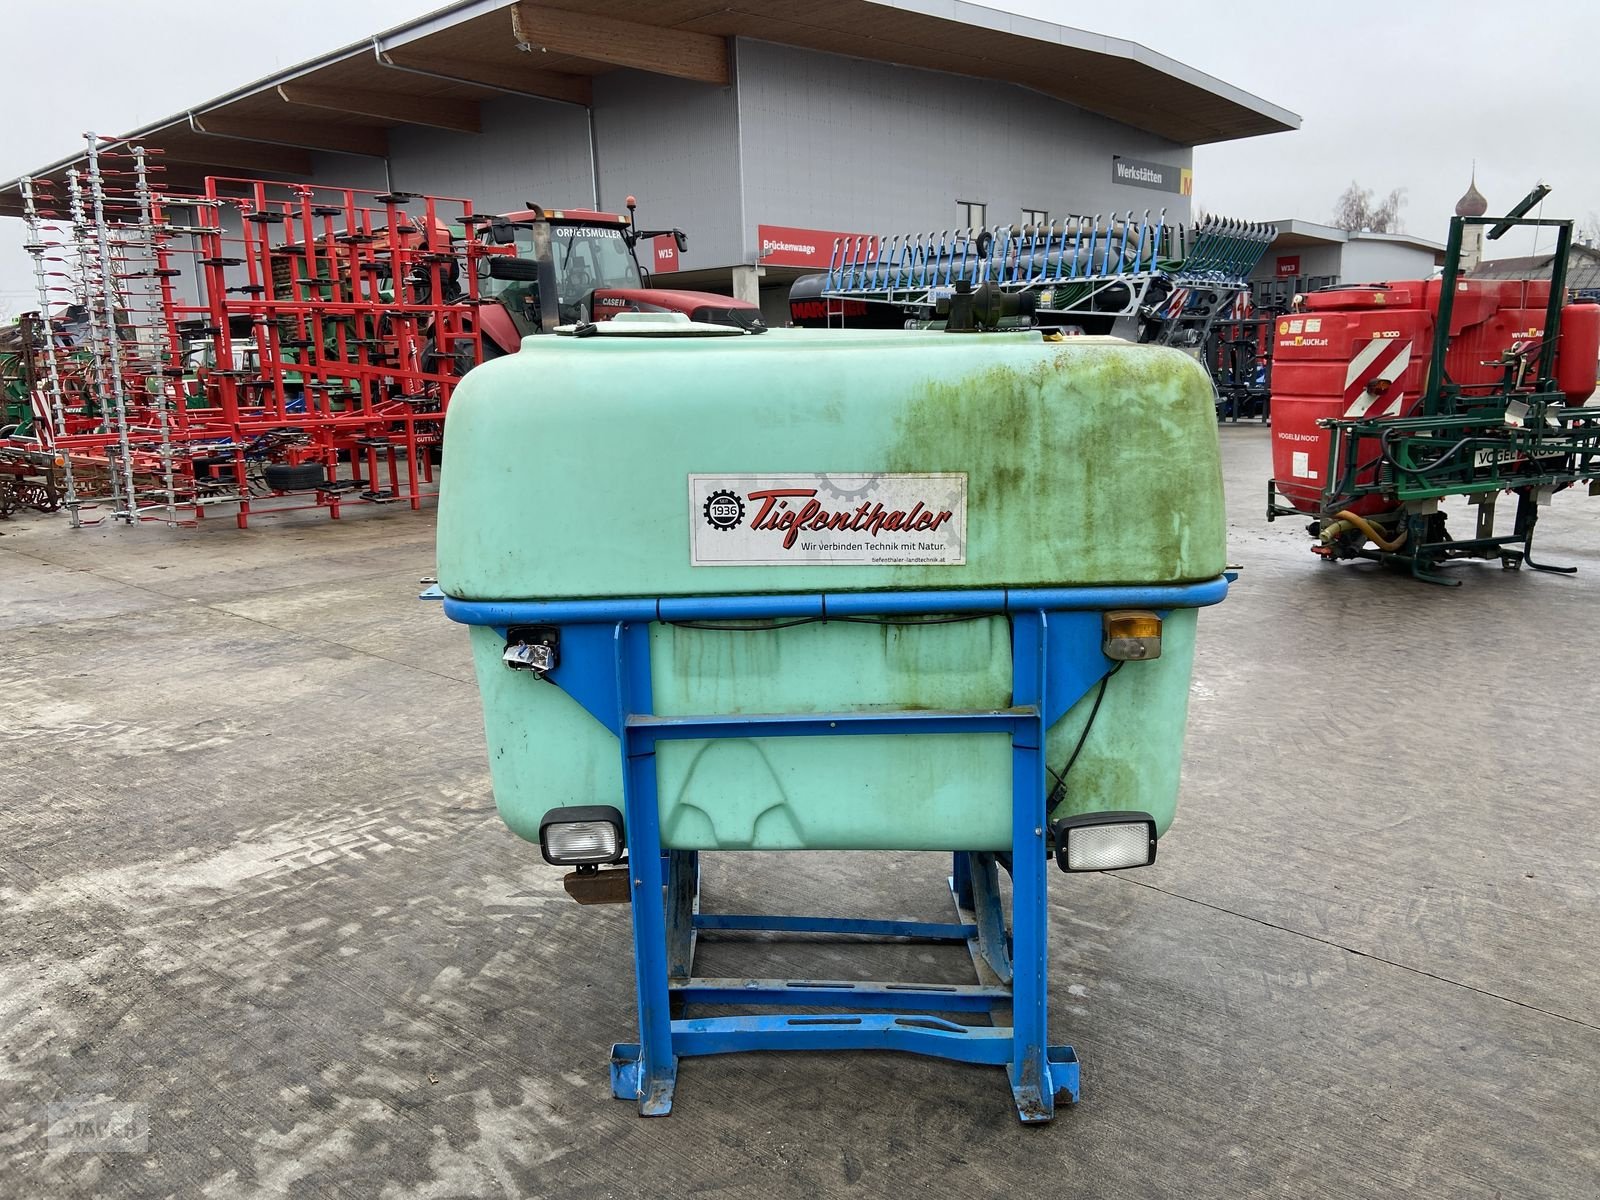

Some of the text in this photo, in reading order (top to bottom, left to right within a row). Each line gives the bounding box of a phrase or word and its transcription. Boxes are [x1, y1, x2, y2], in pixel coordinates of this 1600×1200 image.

[1117, 163, 1162, 183] Werkstätten
[658, 249, 673, 258] W15
[763, 239, 816, 255] Brückenwaage
[711, 505, 738, 516] 1936
[747, 488, 952, 550] Tiefenthaler
[800, 542, 946, 551] Wir verbinden Technik mit Natur.
